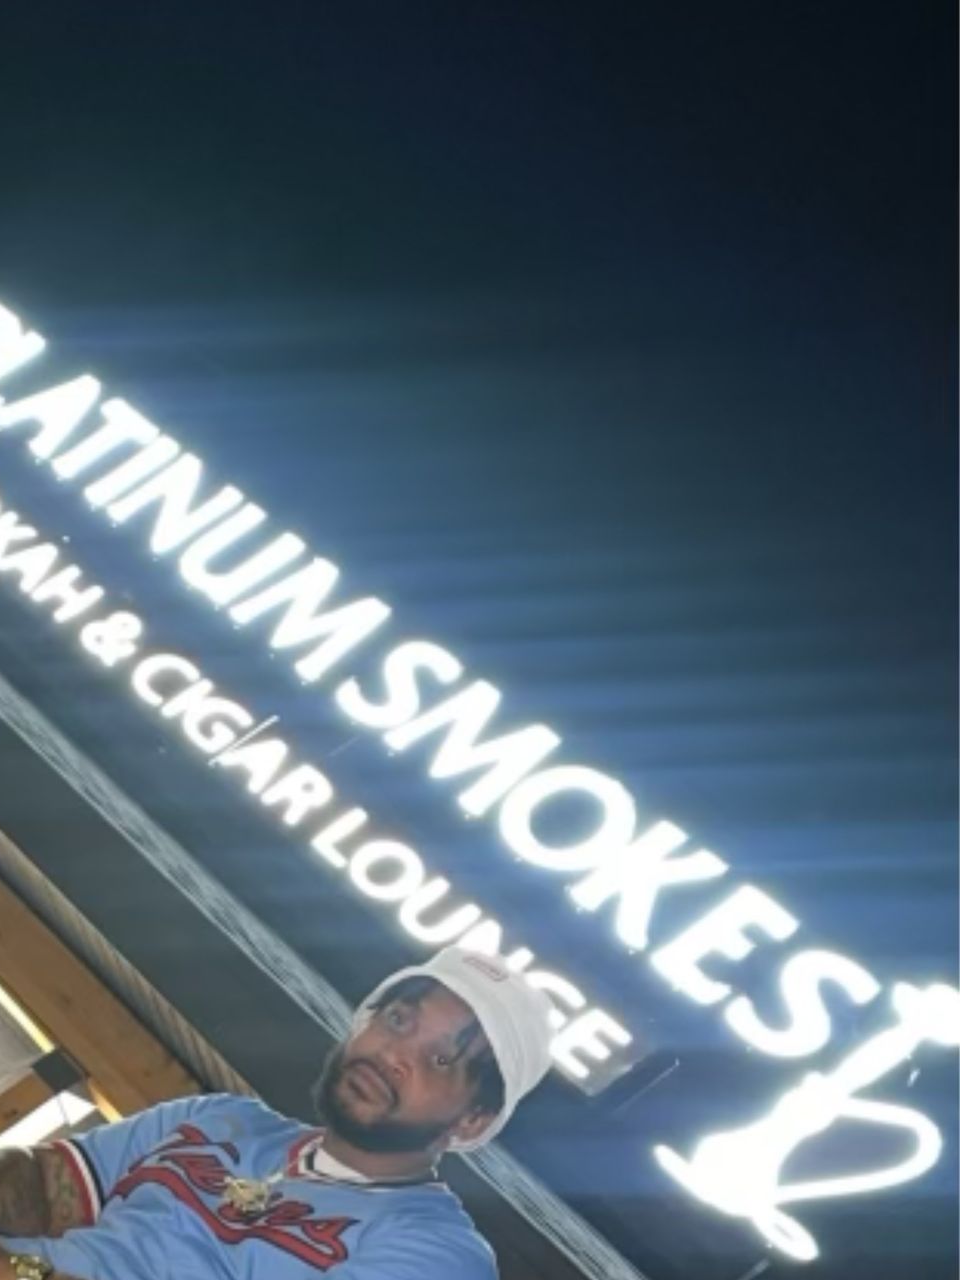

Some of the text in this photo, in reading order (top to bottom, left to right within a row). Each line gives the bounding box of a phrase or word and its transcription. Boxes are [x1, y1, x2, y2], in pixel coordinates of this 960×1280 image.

[79, 611, 144, 669] &
[131, 653, 334, 827] CIGAR
[336, 639, 881, 1059] SMOKES
